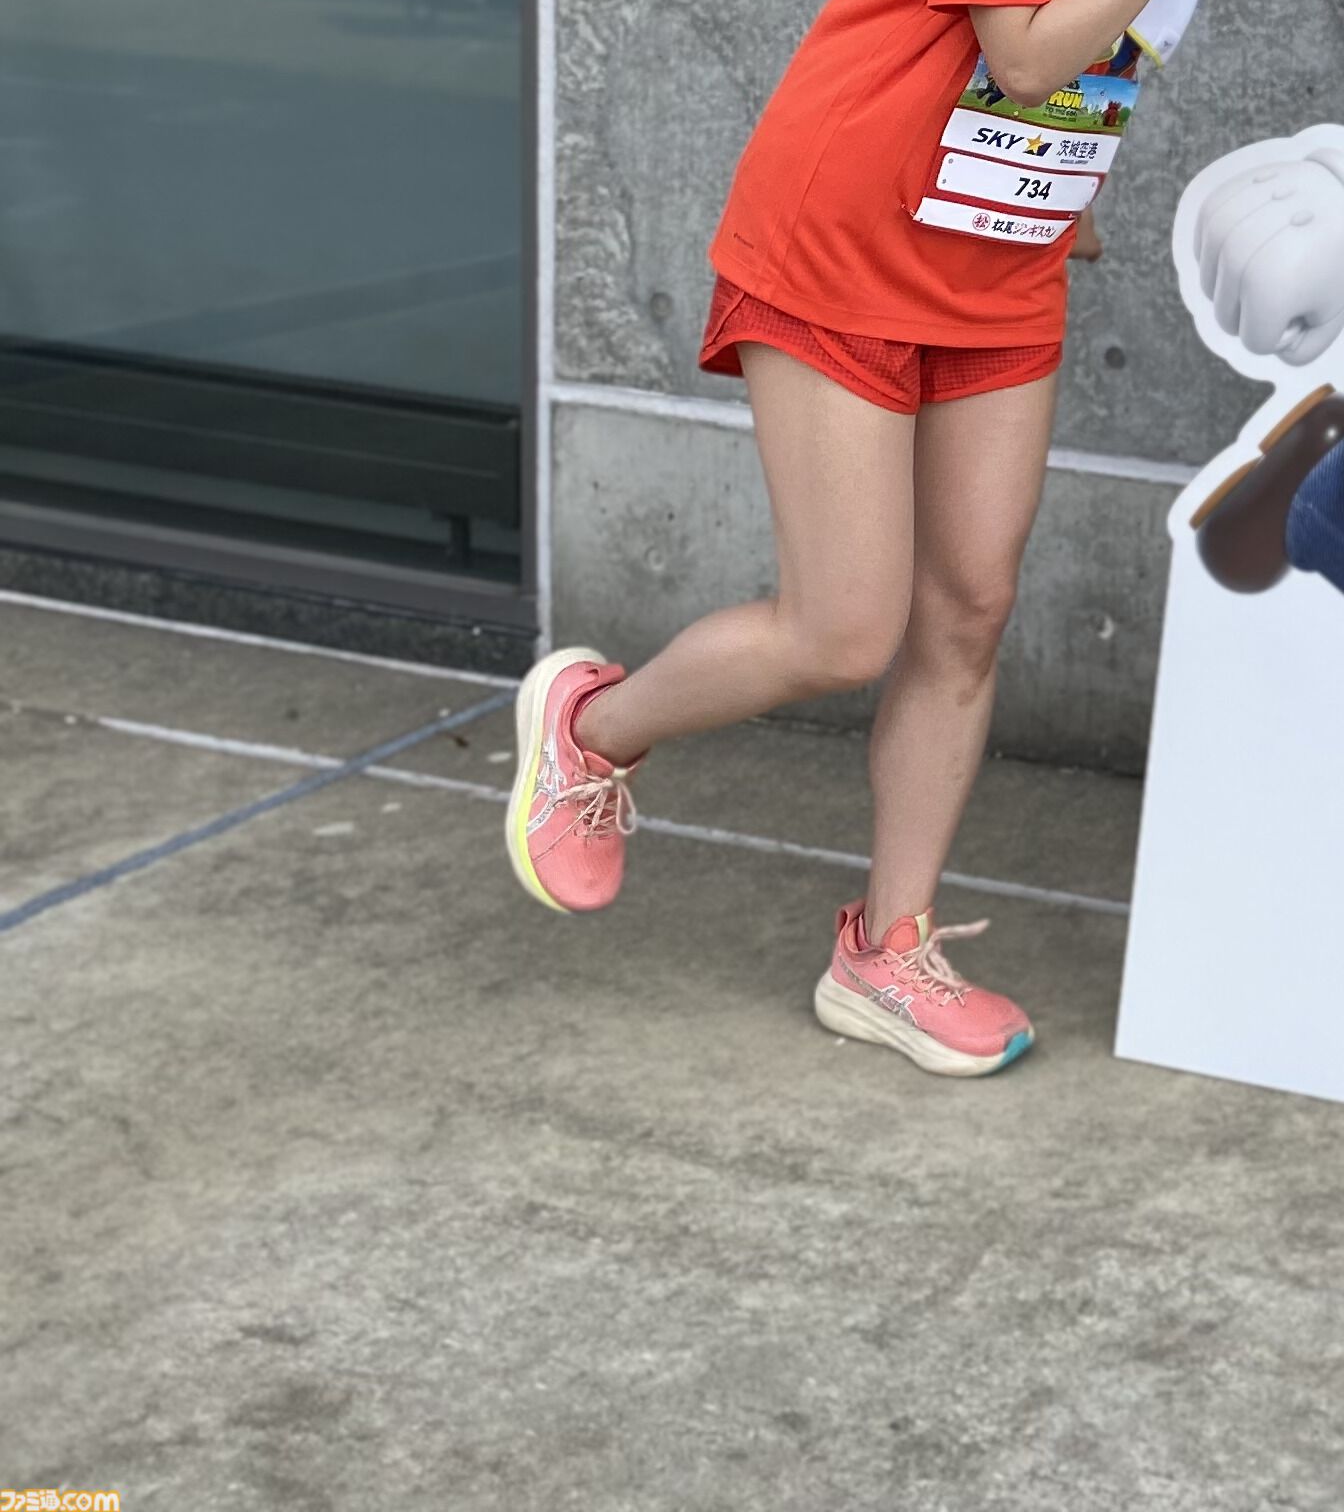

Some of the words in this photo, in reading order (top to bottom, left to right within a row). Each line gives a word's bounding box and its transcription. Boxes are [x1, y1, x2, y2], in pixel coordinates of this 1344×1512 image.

[1046, 89, 1084, 111] RUN
[971, 127, 1025, 150] SKY
[1014, 177, 1053, 200] 734
